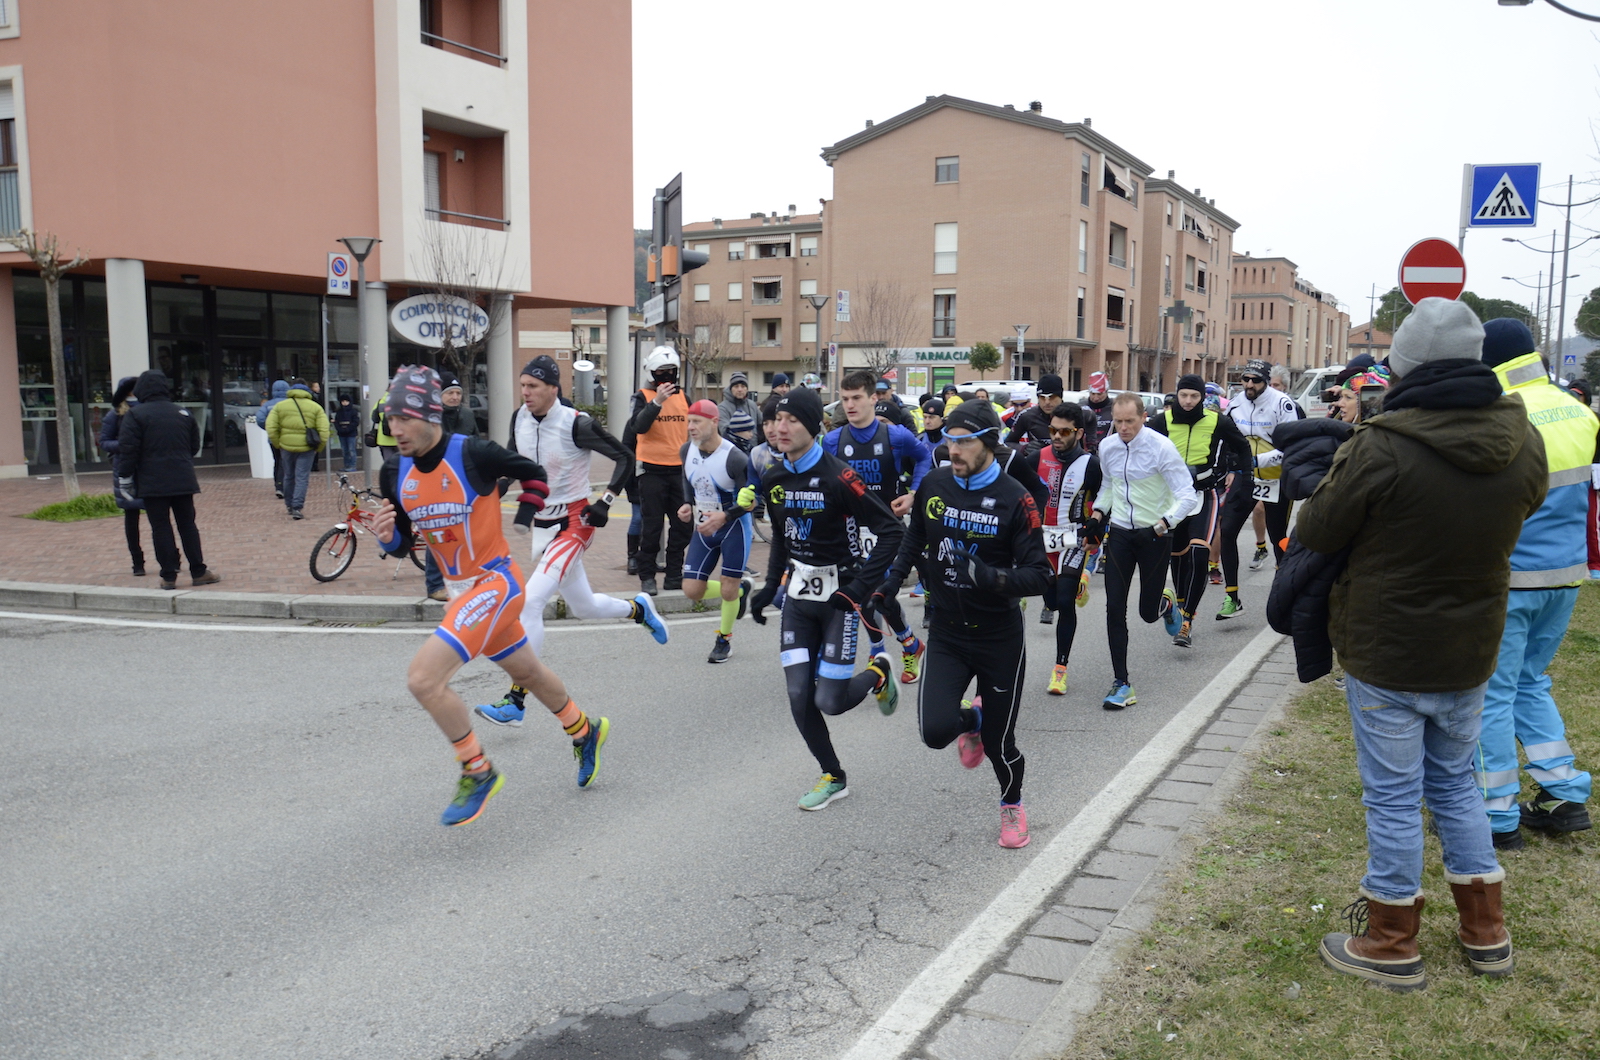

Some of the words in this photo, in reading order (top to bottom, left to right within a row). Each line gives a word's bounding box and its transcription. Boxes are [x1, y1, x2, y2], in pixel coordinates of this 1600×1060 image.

[400, 303, 436, 321] COLPO
[437, 303, 487, 326] DOCCIO
[419, 321, 469, 339] OTTCA
[915, 351, 970, 361] FARMACIA
[847, 458, 881, 473] ZERO
[1253, 484, 1270, 498] 22
[428, 502, 474, 516] CAMPANIA
[416, 513, 464, 530] TRIATHLON
[427, 529, 458, 544] ITA
[1049, 533, 1065, 549] 31
[798, 577, 823, 597] 29
[841, 611, 854, 660] ZEROTREN
